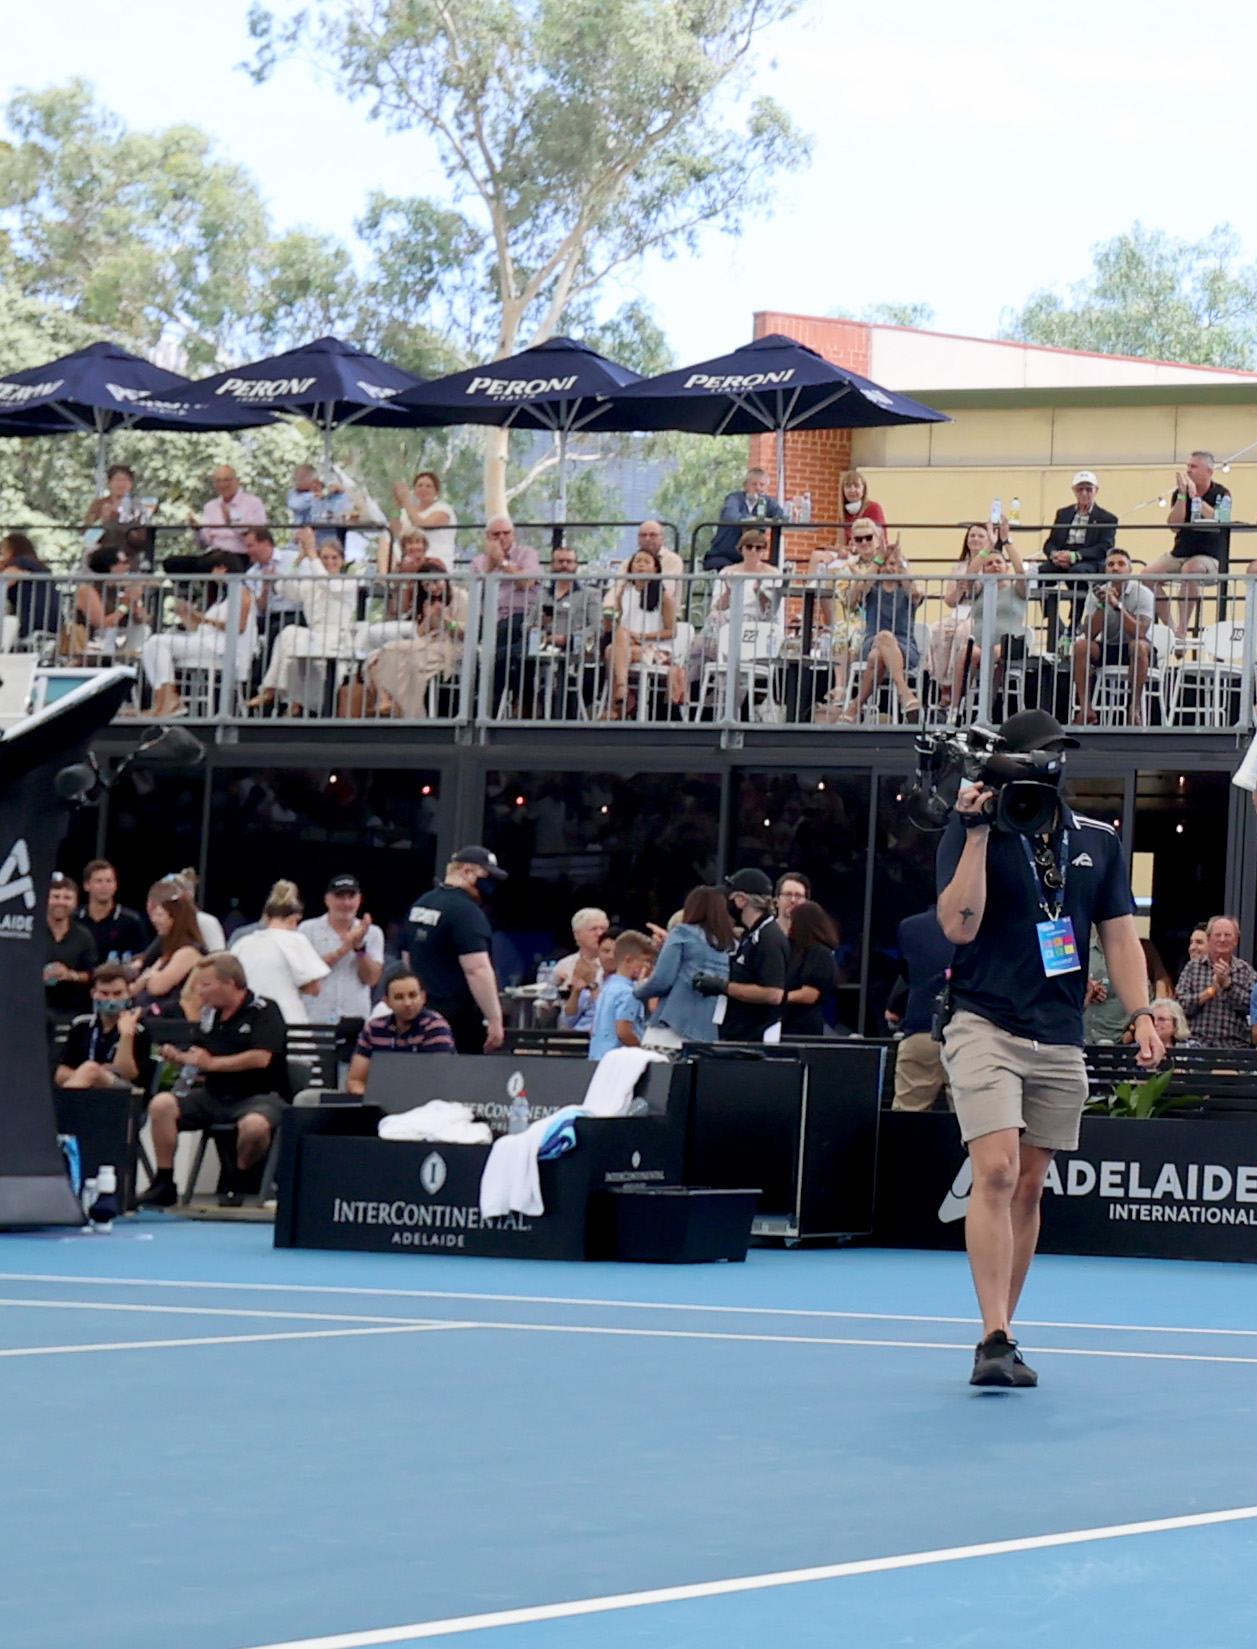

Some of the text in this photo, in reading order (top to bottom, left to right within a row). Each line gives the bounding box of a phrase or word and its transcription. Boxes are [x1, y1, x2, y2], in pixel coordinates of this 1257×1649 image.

[215, 377, 317, 397] PERONI
[465, 375, 579, 396] PERONI
[683, 368, 796, 389] PERONI
[391, 1231, 466, 1248] ADELAIDE
